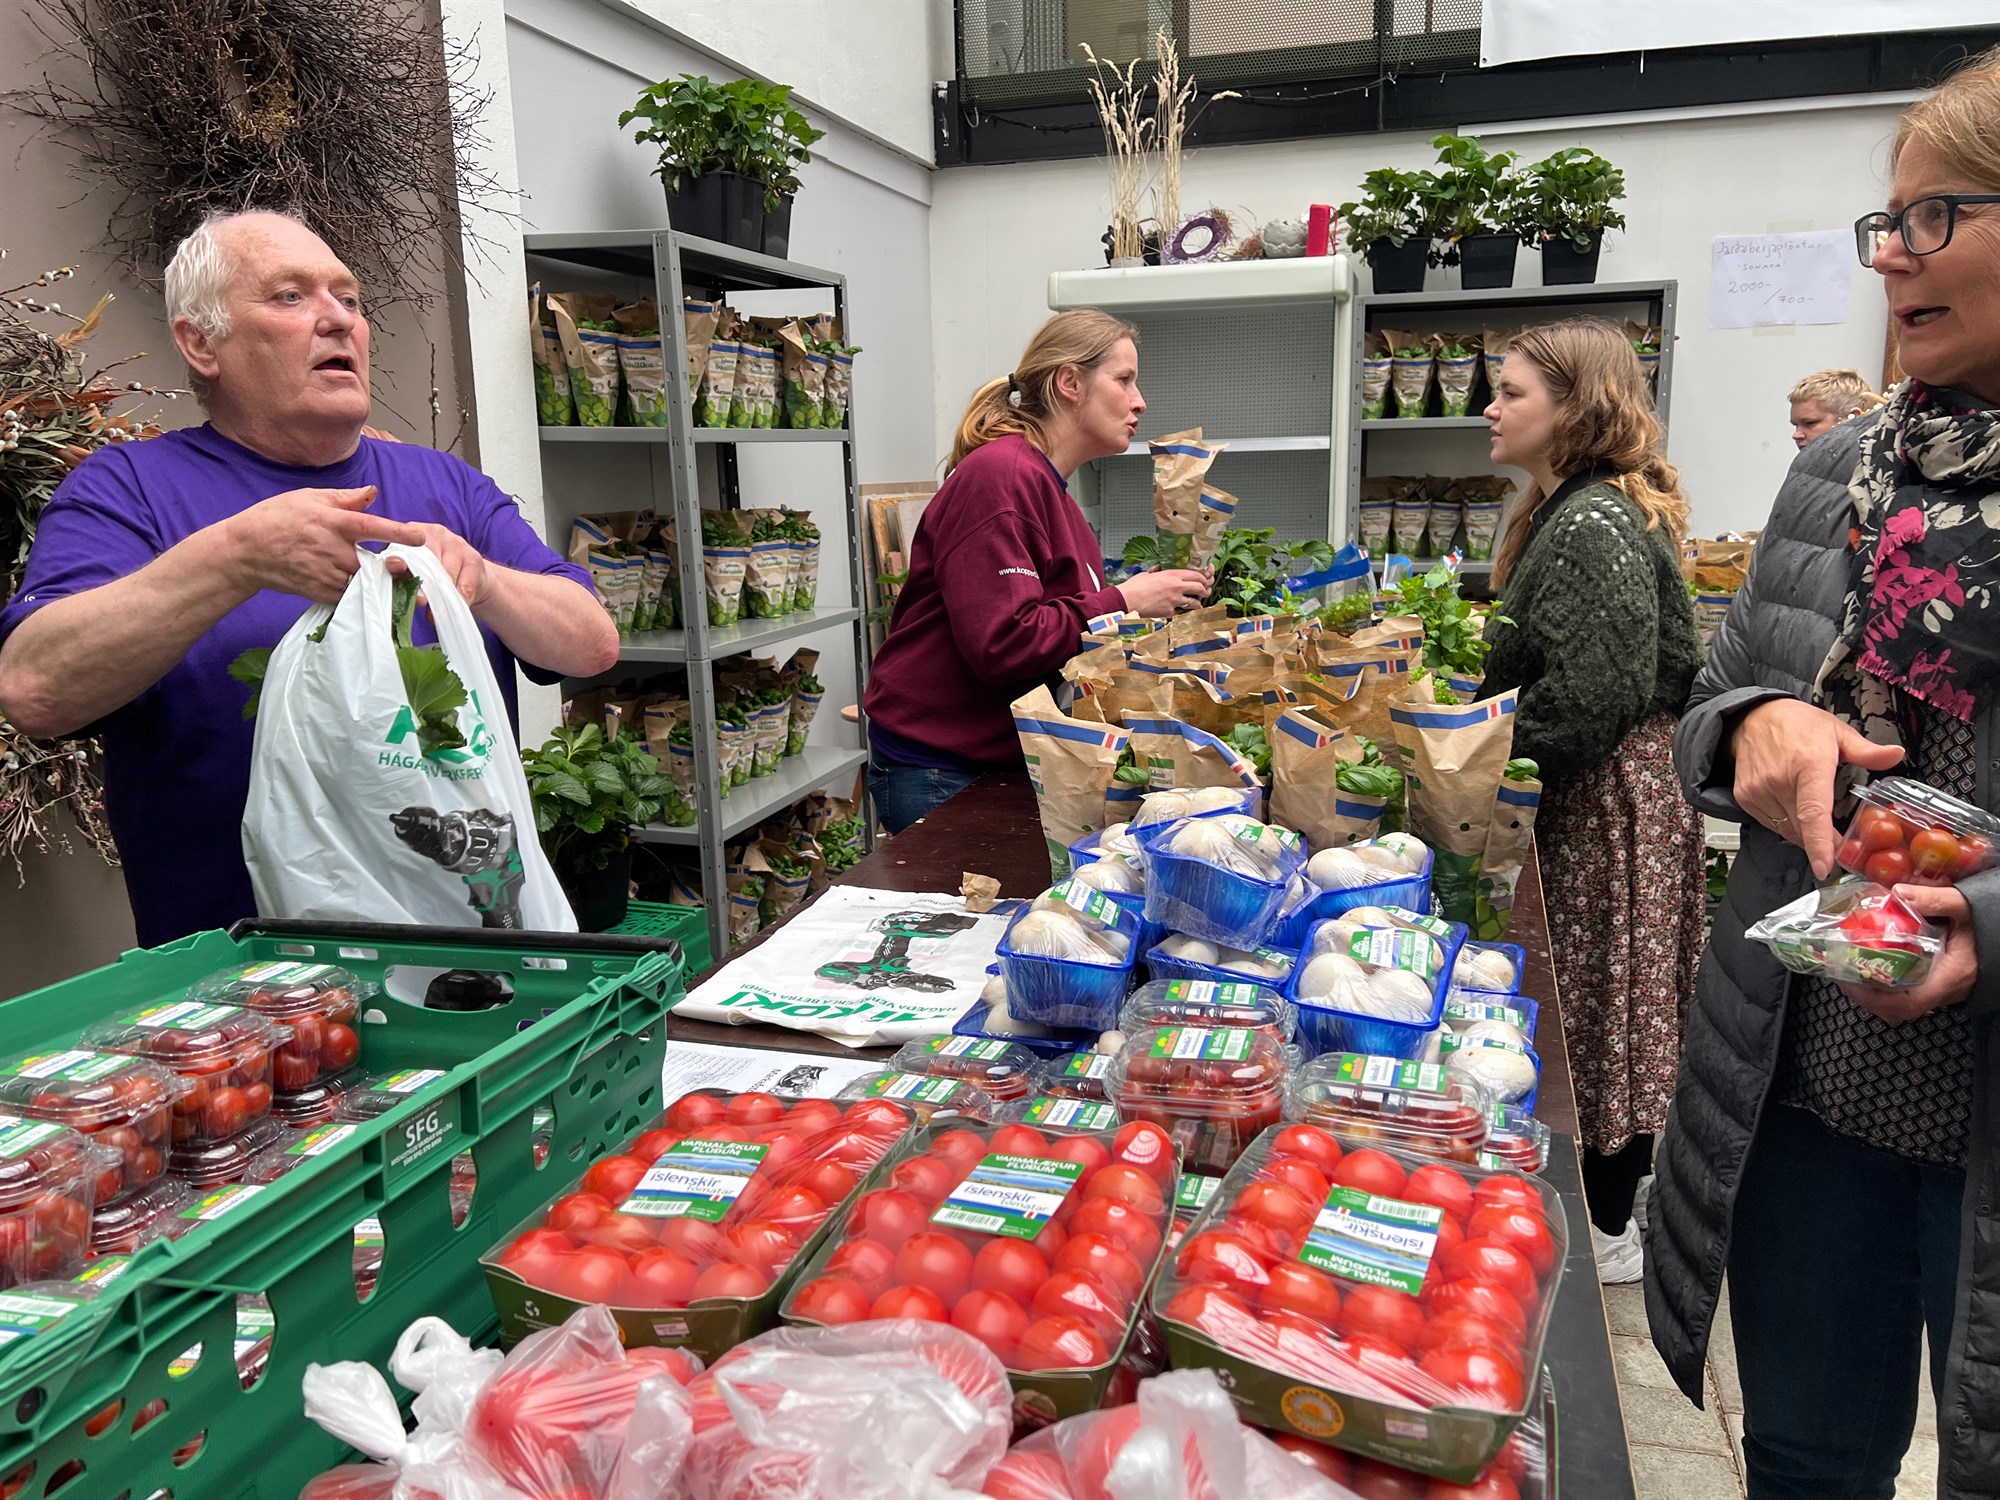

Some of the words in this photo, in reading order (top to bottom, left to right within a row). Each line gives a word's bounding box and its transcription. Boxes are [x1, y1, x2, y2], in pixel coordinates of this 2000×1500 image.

[405, 1110, 438, 1148] SFG
[681, 1140, 761, 1152] VARMALÆKUR
[996, 1154, 1077, 1171] VARMALÆKUR
[650, 1170, 721, 1188] íslenskir
[964, 1185, 1036, 1203] íslenskir
[1344, 1222, 1424, 1251] íslenskir
[1307, 1254, 1408, 1290] VARMALÆKUR
